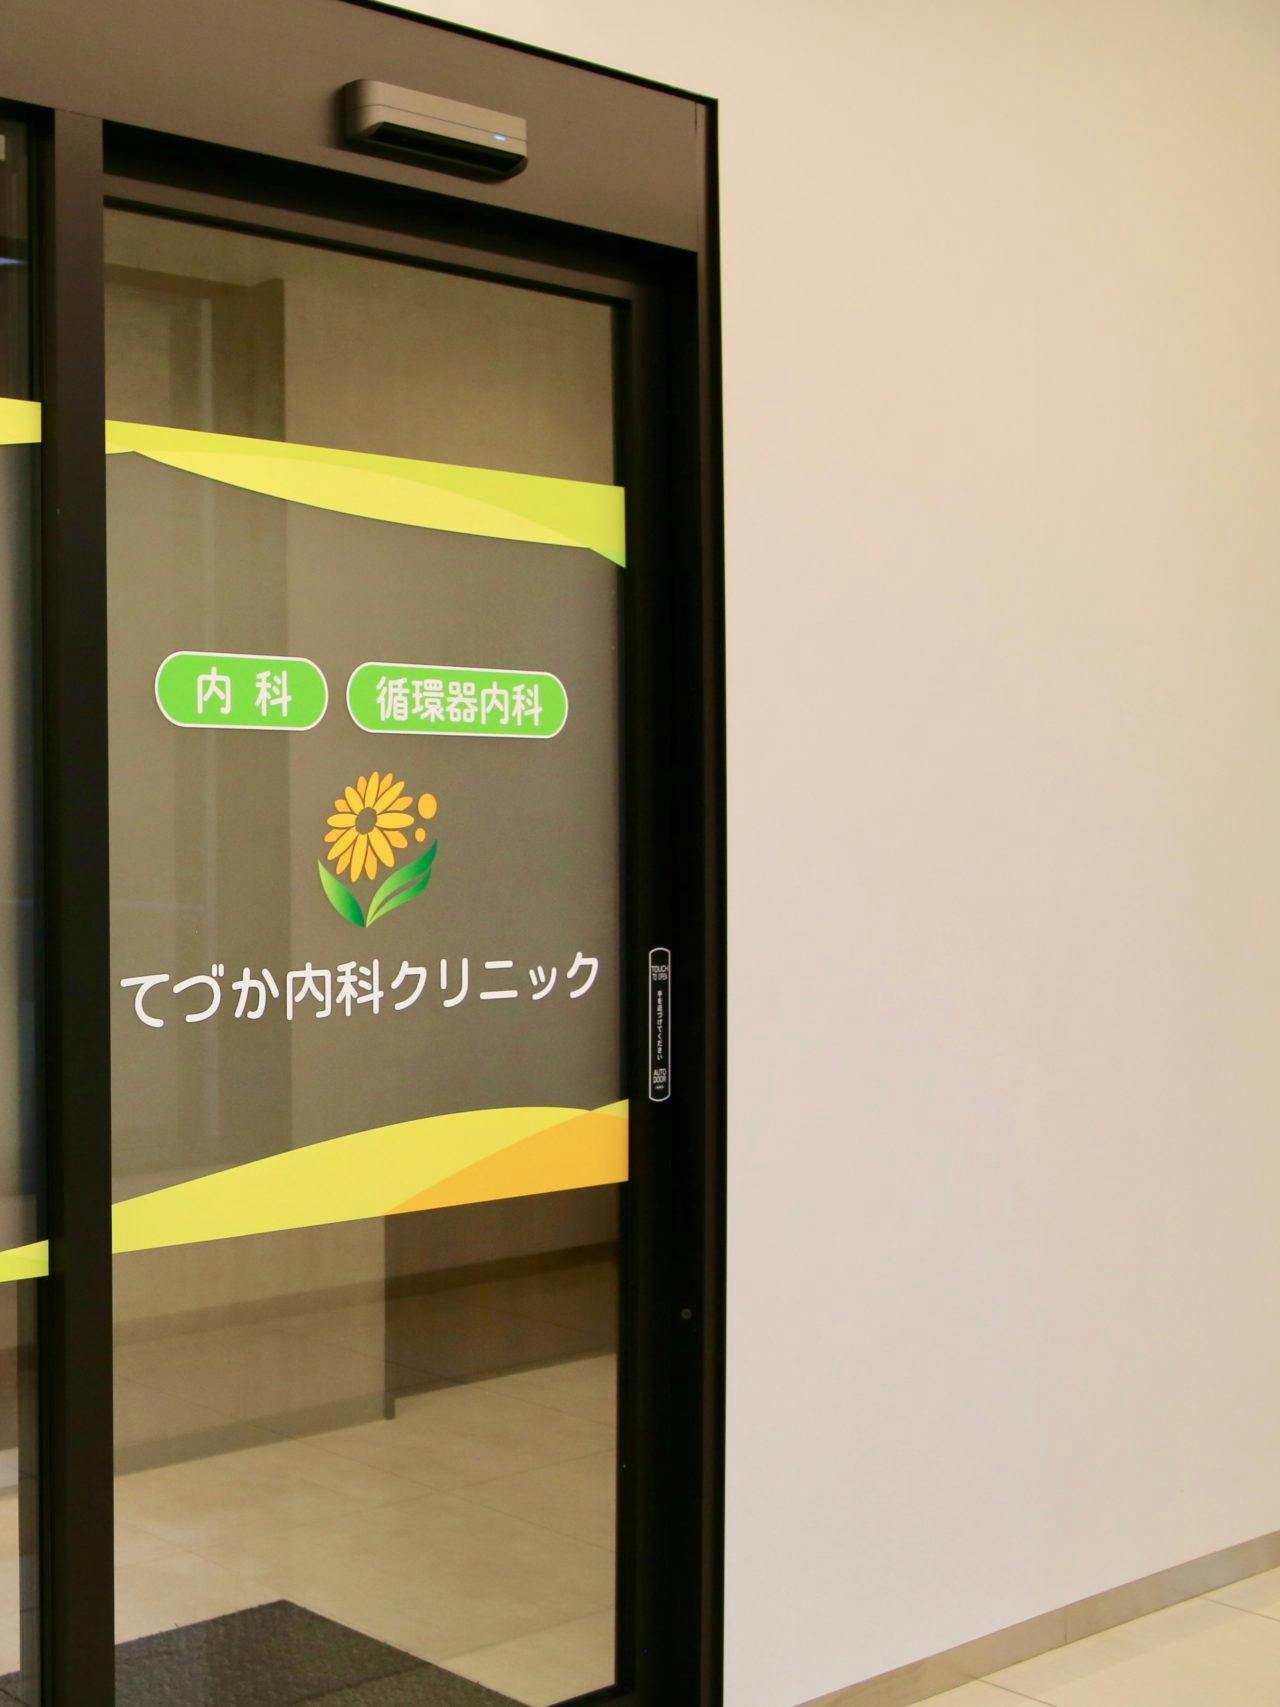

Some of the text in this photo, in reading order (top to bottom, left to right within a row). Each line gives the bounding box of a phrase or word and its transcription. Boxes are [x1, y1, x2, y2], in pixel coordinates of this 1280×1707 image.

[196, 666, 293, 718] 内科
[375, 675, 544, 727] 循環器内科
[120, 951, 600, 1028] てづか内科クリニック
[653, 1068, 667, 1076] AUTO
